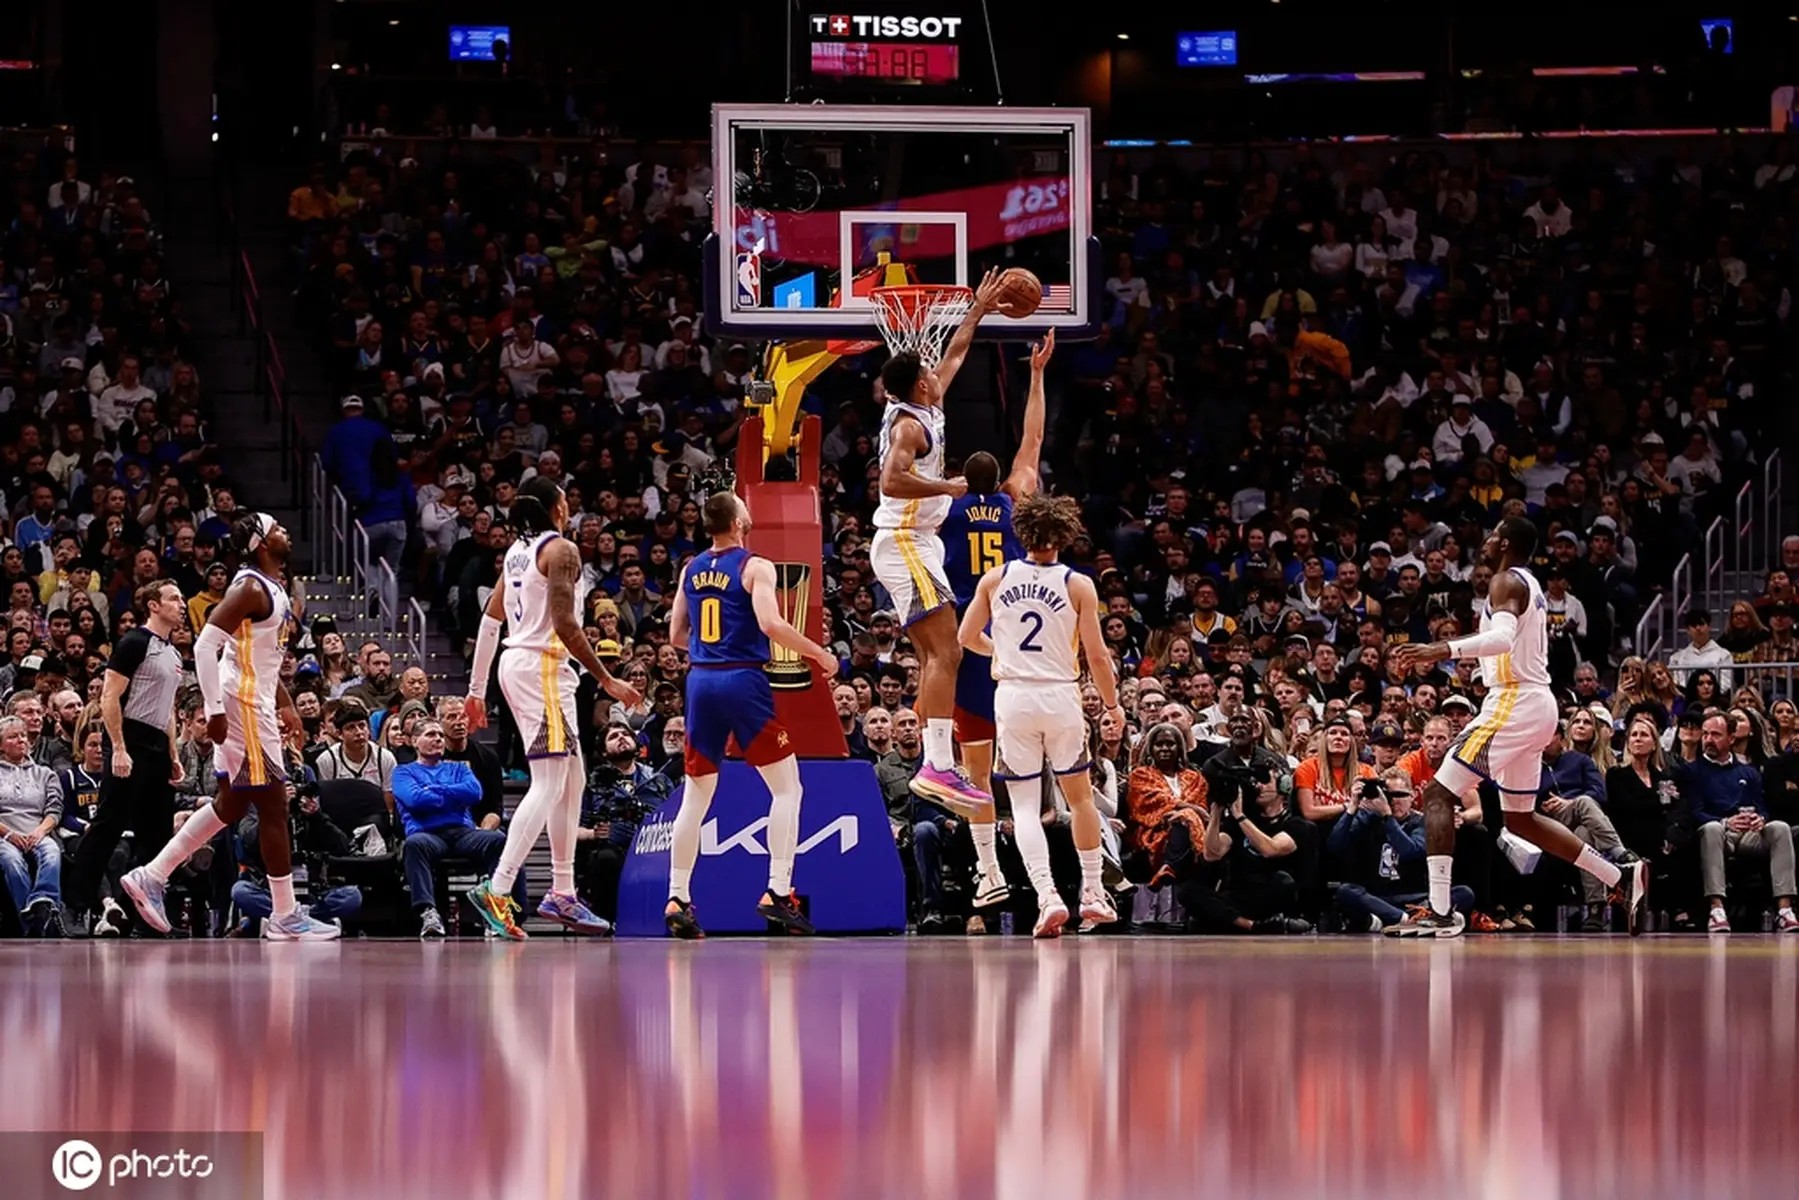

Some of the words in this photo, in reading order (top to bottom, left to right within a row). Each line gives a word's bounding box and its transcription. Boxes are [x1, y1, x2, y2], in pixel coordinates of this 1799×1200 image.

[853, 15, 962, 38] TISSOT
[967, 531, 1004, 576] 15
[691, 572, 731, 592] BRAUN
[999, 583, 1068, 613] PODZIEMSKI
[699, 596, 722, 644] 0
[1019, 611, 1043, 652] 2
